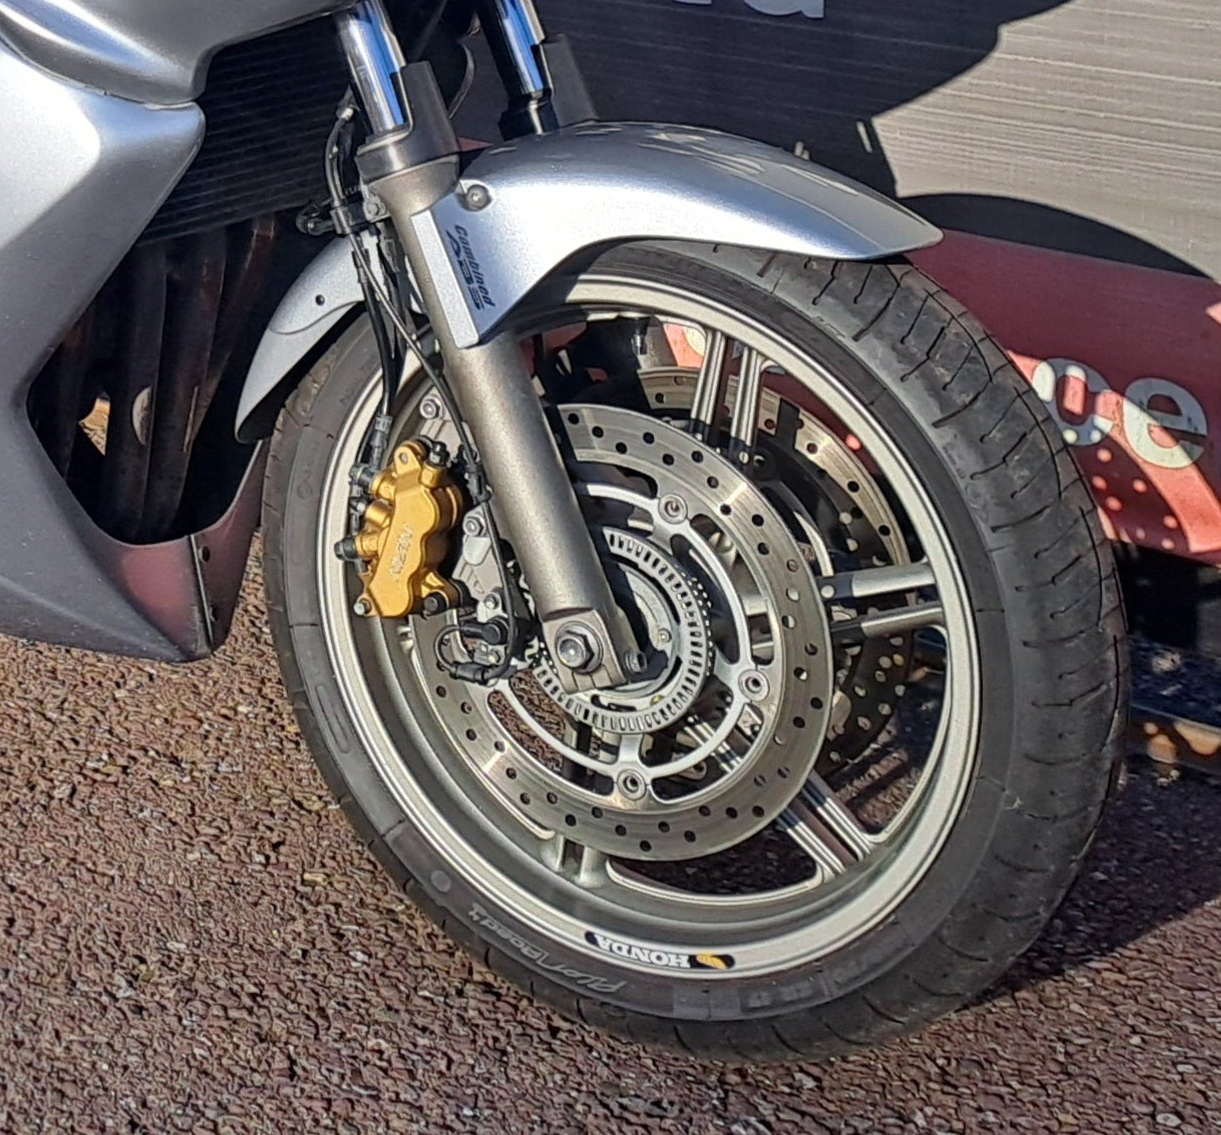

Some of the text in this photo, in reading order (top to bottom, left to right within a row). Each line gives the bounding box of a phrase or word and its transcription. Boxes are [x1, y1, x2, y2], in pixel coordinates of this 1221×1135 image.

[445, 229, 486, 310] ABS
[455, 224, 496, 307] Combined
[593, 934, 691, 968] HONDA
